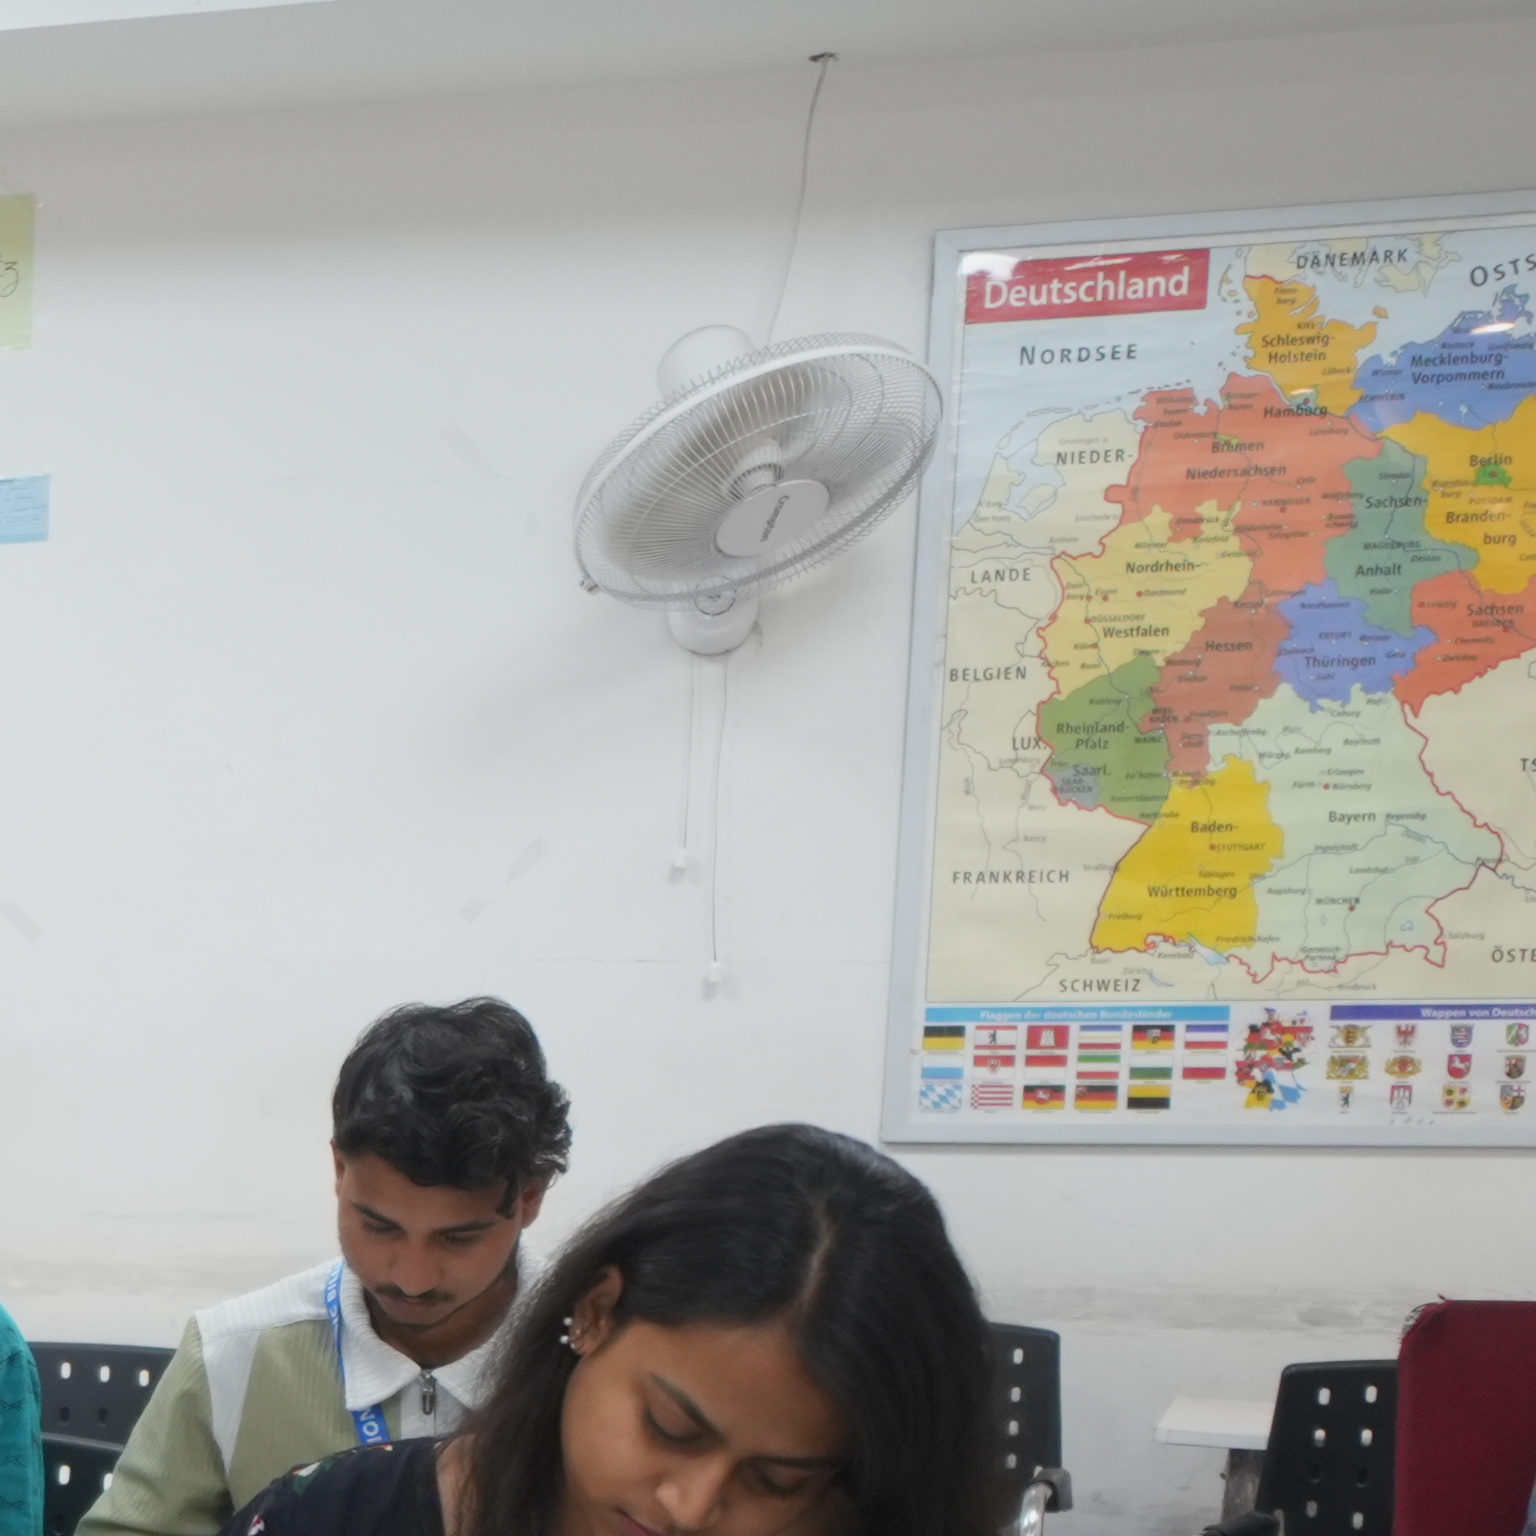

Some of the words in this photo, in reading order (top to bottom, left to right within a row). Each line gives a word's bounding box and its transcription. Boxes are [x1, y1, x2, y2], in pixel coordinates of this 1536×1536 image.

[1297, 249, 1408, 270] DÄNEMARK
[984, 266, 1190, 309] Deutschland
[1262, 335, 1334, 347] Schleswig-
[1020, 344, 1138, 366] NORDSEE
[1269, 351, 1326, 363] Holstein
[1411, 353, 1508, 367] Mecklenburg-
[1412, 370, 1505, 385] Vorpommern
[1264, 406, 1327, 419] Hamburg
[1056, 449, 1133, 465] NIEDER-
[1470, 454, 1512, 467] Berlin
[1186, 463, 1286, 480] Niedersachsen
[1366, 496, 1428, 508] Sachsen-
[1446, 511, 1510, 523] Branden-
[1484, 533, 1517, 547] burg
[1126, 561, 1201, 573] Nordrhein-
[1356, 564, 1402, 577] Anhalt
[971, 568, 1031, 583] LANDE
[1467, 603, 1523, 616] Sachsen
[1103, 626, 1169, 638] Westfalen
[1205, 640, 1252, 651] Hessen
[1305, 655, 1375, 670] Thüringen
[950, 667, 1027, 682] BELGIEN
[1057, 721, 1130, 735] Rheinland-
[1013, 738, 1047, 750] LUX.
[1076, 738, 1109, 750] Pfalz
[1073, 763, 1111, 776] Saarl.
[1329, 811, 1376, 825] Bayern
[1191, 821, 1238, 833] Baden-
[953, 870, 1069, 884] FRANKREICH
[1147, 885, 1237, 900] Württemberg
[1059, 979, 1140, 993] SCHWEIZ
[1421, 1008, 1466, 1019] Wappen
